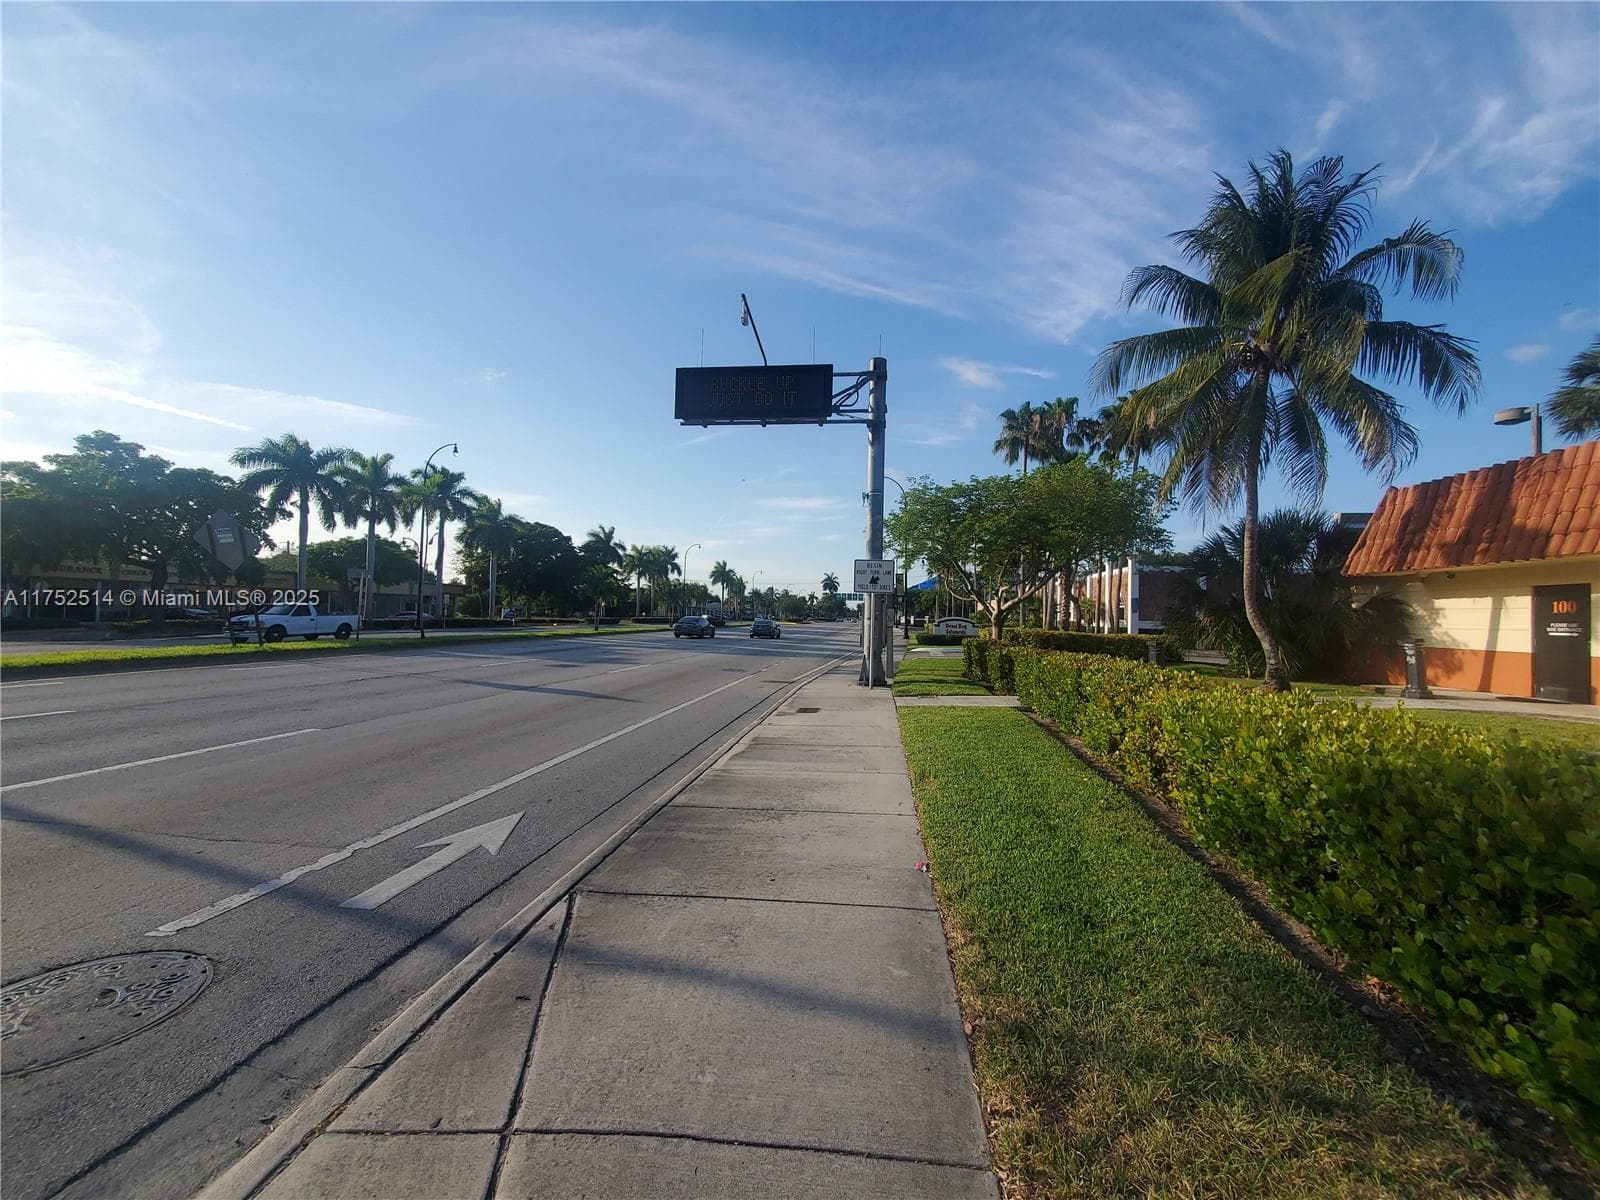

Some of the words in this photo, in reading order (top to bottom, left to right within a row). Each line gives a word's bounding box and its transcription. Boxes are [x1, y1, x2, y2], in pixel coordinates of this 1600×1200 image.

[776, 375, 795, 391] UP
[754, 391, 774, 407] DO
[783, 391, 798, 408] IT
[1552, 600, 1577, 614] 100
